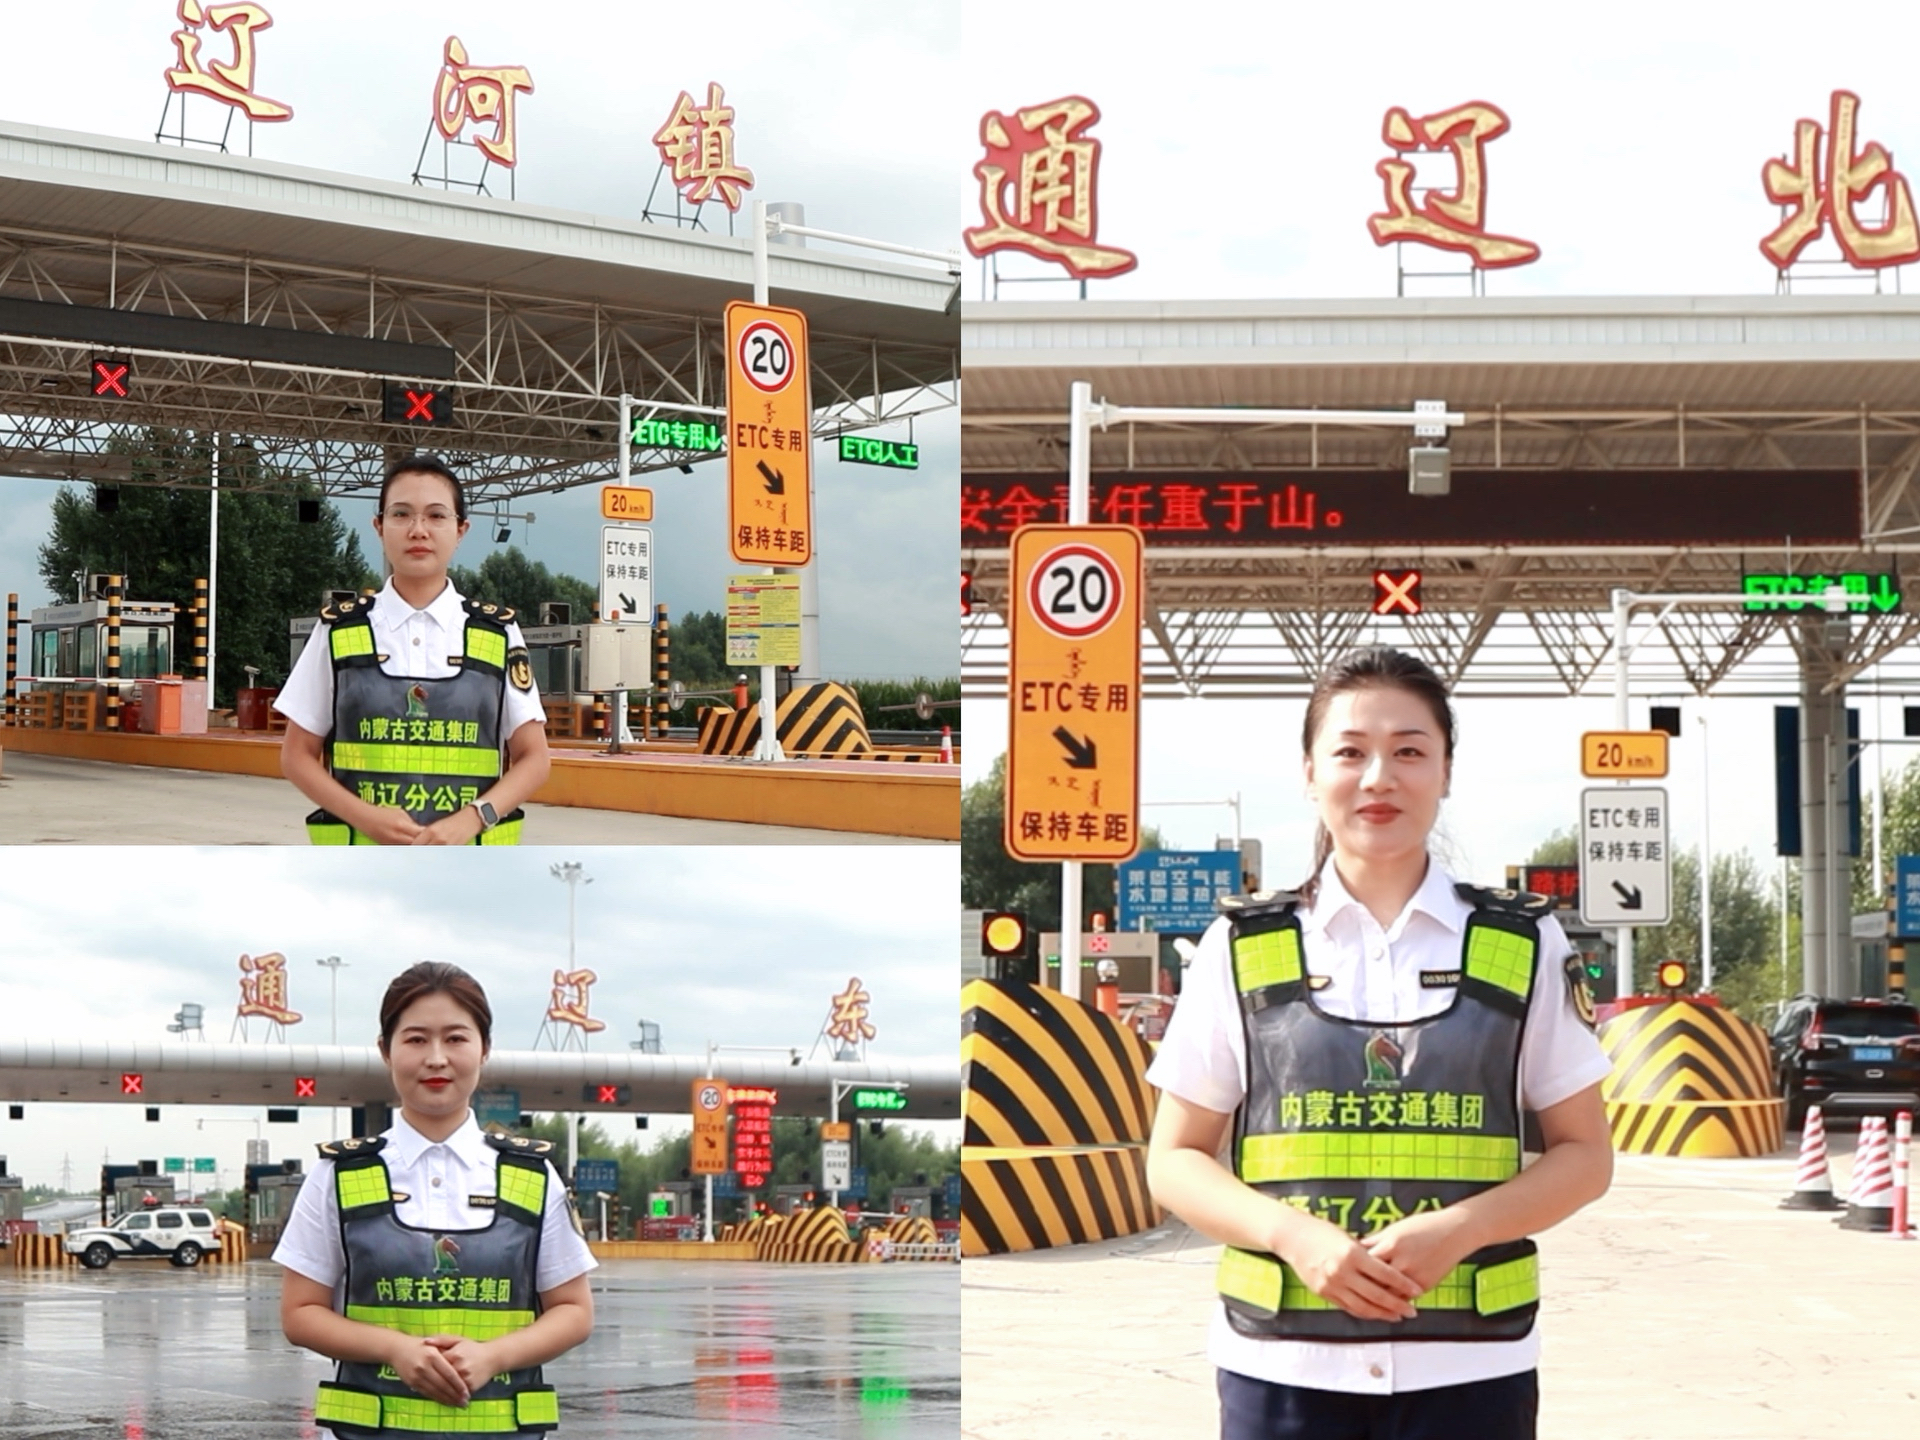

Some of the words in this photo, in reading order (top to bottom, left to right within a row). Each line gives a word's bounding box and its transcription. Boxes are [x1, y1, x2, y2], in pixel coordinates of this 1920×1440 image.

[751, 336, 787, 376] 20
[635, 419, 705, 450] ETC专用
[736, 424, 802, 452] ETC专用
[611, 494, 627, 512] 20
[607, 541, 647, 557] ETC专用
[737, 524, 805, 553] 保持车距
[607, 564, 648, 581] 保持车距
[1050, 566, 1107, 614] 20
[1021, 681, 1128, 712] ETC专用
[360, 717, 478, 743] 内蒙古交通集团
[1597, 742, 1622, 768] 20
[1020, 811, 1128, 842] 保持车距
[1589, 808, 1660, 829] ETC专用
[1588, 841, 1662, 862] 保持车距
[704, 1091, 719, 1106] 20
[1280, 1091, 1484, 1129] 内蒙古交通集团
[376, 1276, 511, 1303] 内蒙古交通集团
